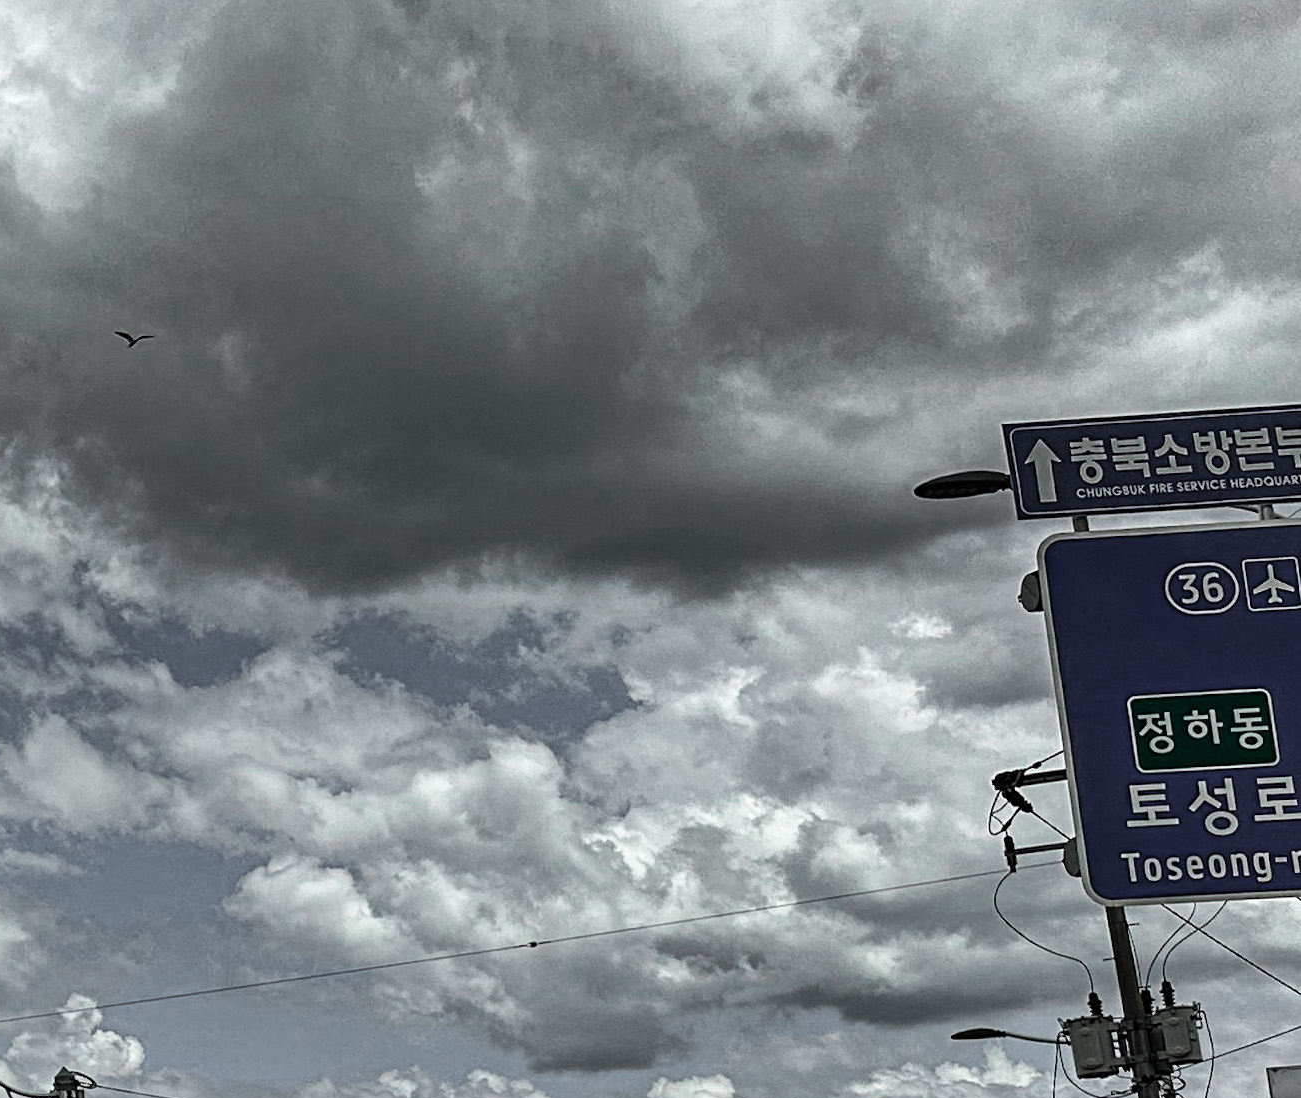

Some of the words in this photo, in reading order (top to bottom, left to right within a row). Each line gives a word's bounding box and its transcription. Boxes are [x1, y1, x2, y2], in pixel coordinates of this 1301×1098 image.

[1069, 427, 1301, 485] 충북소방본부
[1076, 485, 1147, 500] CHUNGBUK
[1149, 483, 1174, 495] FIRE
[1177, 479, 1228, 493] SERVICE
[1230, 474, 1301, 489] HEADQUAR
[1178, 571, 1225, 605] 36
[1137, 706, 1270, 755] 정하동
[1126, 776, 1301, 836] 토성로
